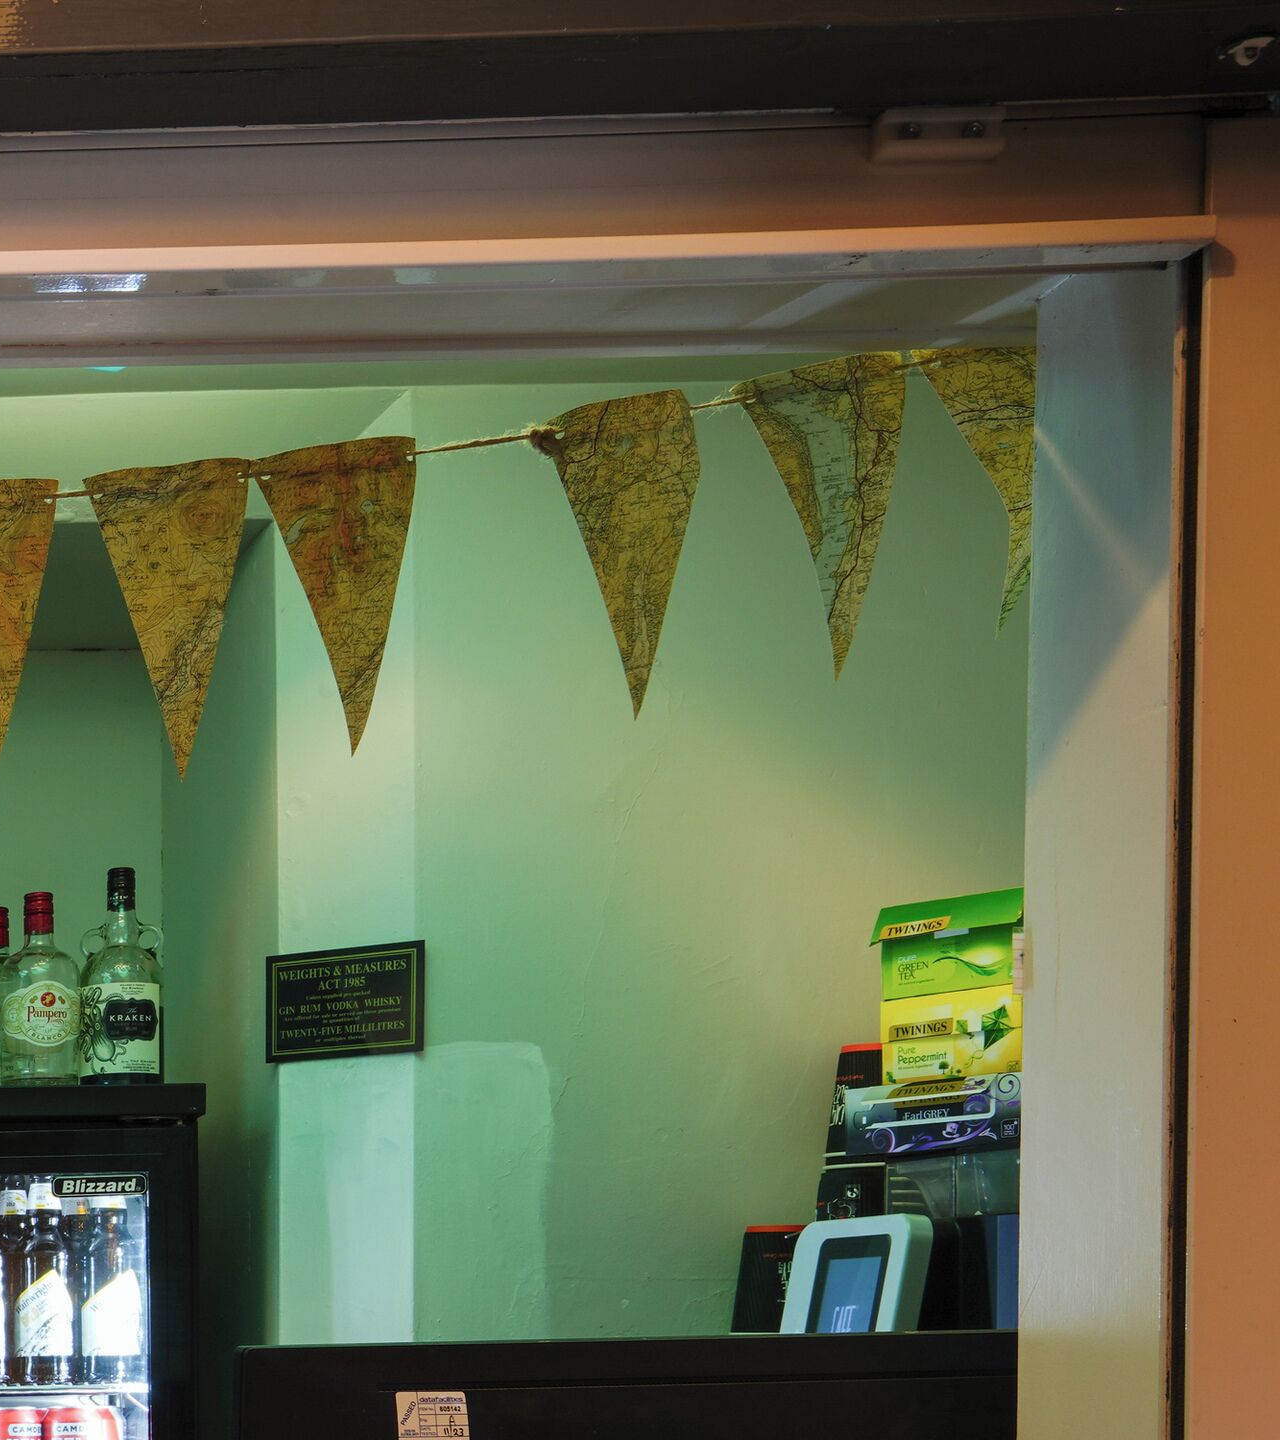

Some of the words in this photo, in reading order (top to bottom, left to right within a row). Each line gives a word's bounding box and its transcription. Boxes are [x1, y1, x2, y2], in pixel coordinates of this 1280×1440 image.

[887, 919, 944, 936] TWININGS
[279, 966, 331, 981] WEIGHTS
[333, 965, 342, 976] &
[345, 958, 407, 975] MEASURES
[897, 960, 930, 973] GREEN
[318, 979, 341, 991] ACT
[343, 976, 366, 989] 1985
[899, 971, 916, 981] TEA
[279, 1005, 296, 1016] GIN
[300, 1003, 321, 1014] RUM
[326, 1001, 359, 1011] VODKA
[364, 996, 403, 1008] WHISKY
[26, 1006, 68, 1024] Pampero
[109, 1014, 153, 1023] KRAKEN
[280, 1026, 341, 1041] TWENTY-FIVE
[344, 1020, 406, 1034] MILLILITRES
[894, 1022, 948, 1038] TWININGS
[897, 1046, 916, 1055] Pure
[897, 1051, 948, 1066] Peppermint
[896, 1083, 958, 1096] TWININGS
[905, 1110, 923, 1121] Earl
[923, 1108, 951, 1119] GREY
[61, 1178, 138, 1194] Blizzard
[400, 1401, 417, 1426] PASSED
